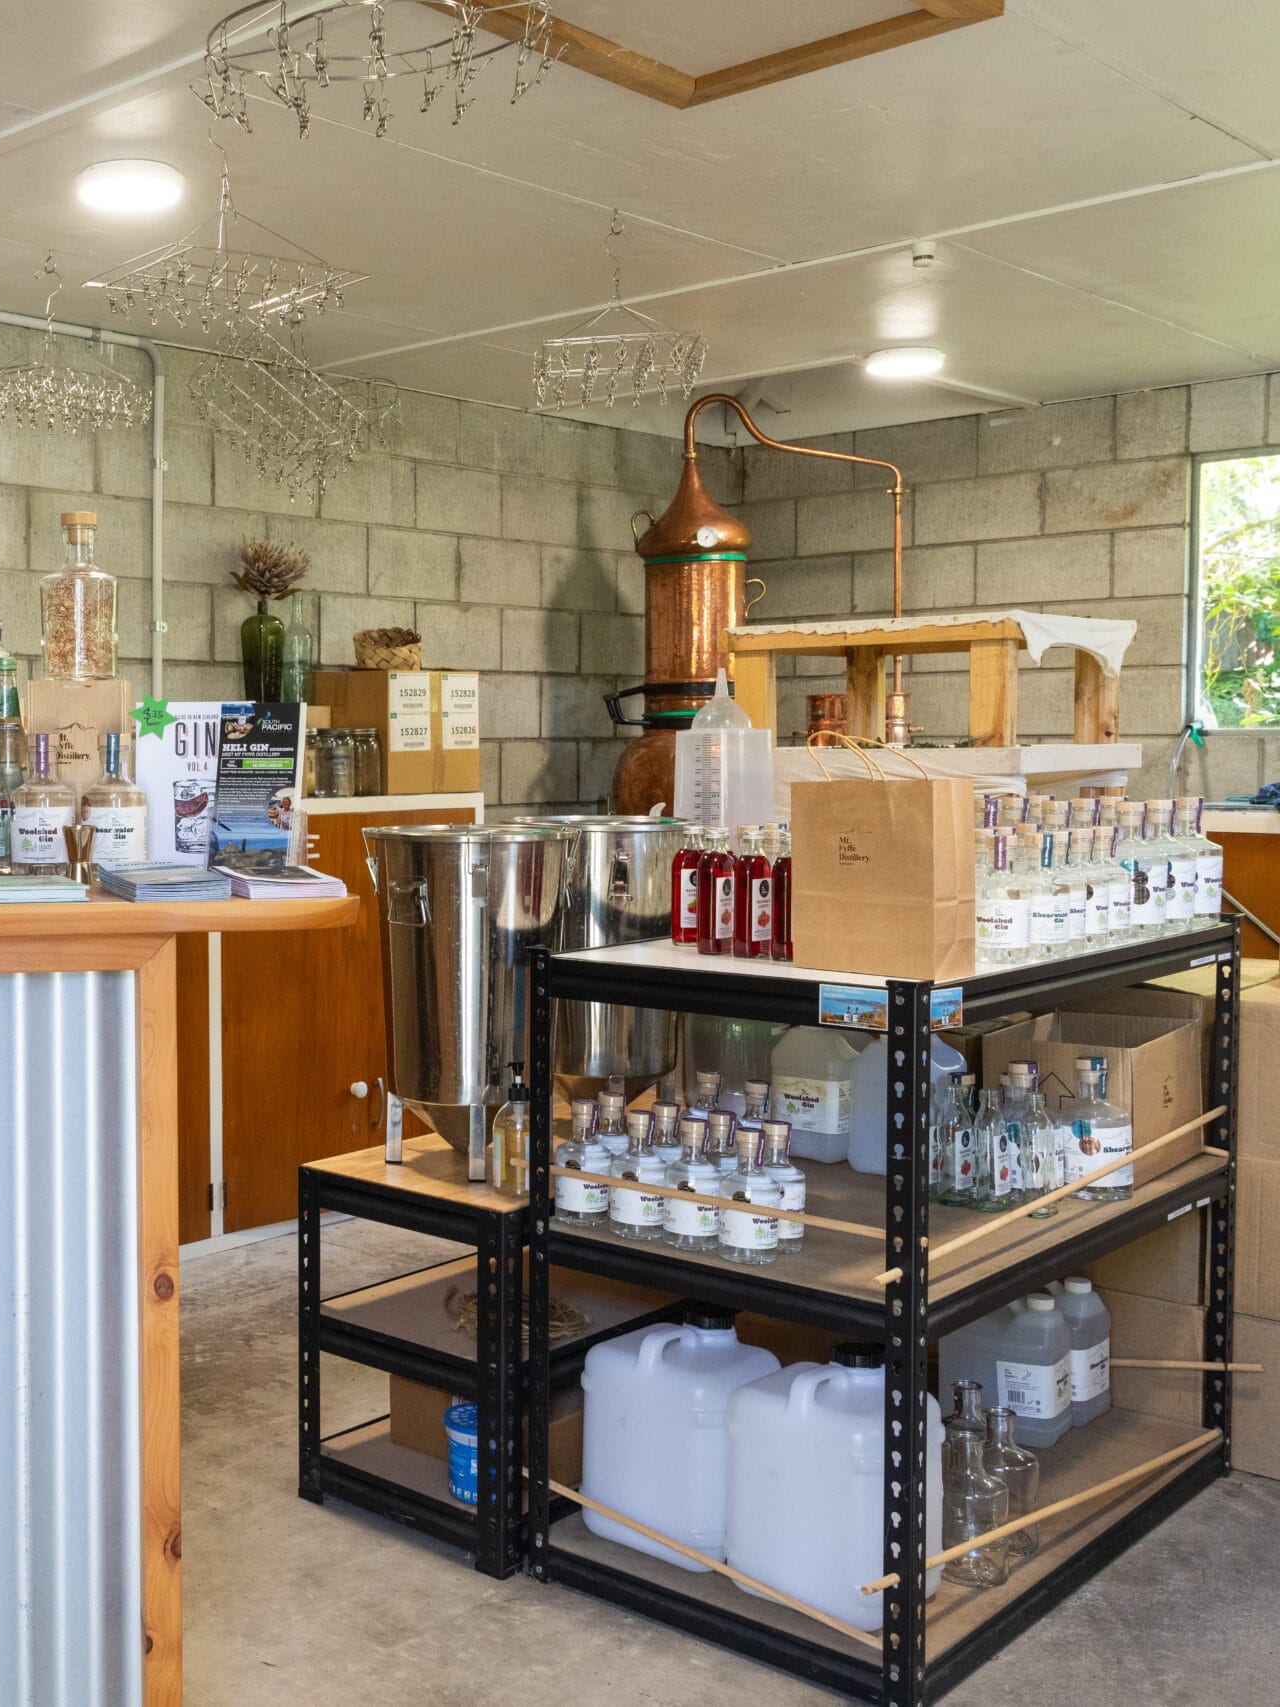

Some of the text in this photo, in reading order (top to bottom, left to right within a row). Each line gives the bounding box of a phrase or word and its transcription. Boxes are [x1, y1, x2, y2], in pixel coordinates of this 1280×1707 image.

[399, 688, 427, 697] 152829
[142, 706, 164, 722] $35
[400, 728, 428, 736] 152827
[451, 726, 476, 734] 152826
[174, 722, 218, 758] GIN
[222, 744, 248, 752] HELI
[249, 744, 270, 752] GIN
[18, 827, 58, 835] Woolshed
[784, 1092, 820, 1104] Woolshed
